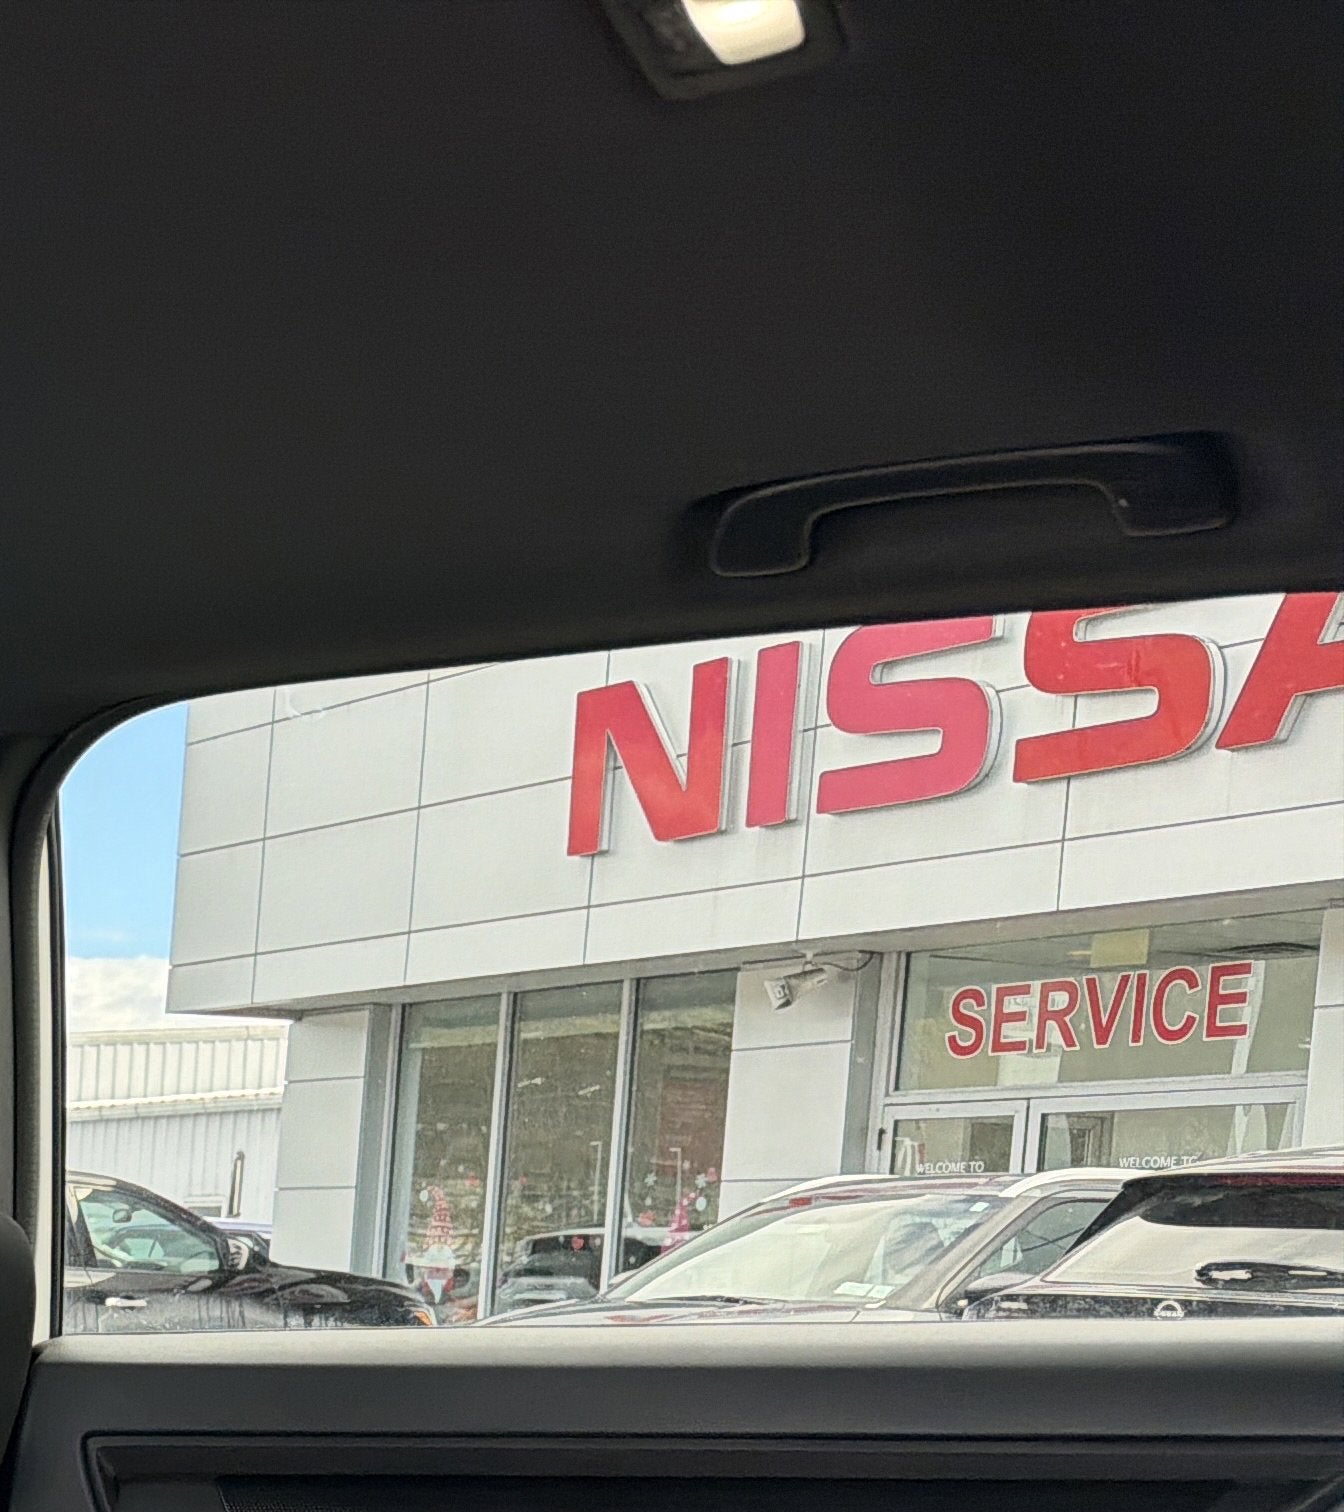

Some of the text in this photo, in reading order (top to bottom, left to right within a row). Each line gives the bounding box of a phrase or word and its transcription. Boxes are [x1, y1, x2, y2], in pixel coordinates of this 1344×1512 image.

[945, 960, 1254, 1059] SERVICE
[916, 1160, 985, 1174] WELCOME TO
[1118, 1155, 1179, 1170] WELCOME
